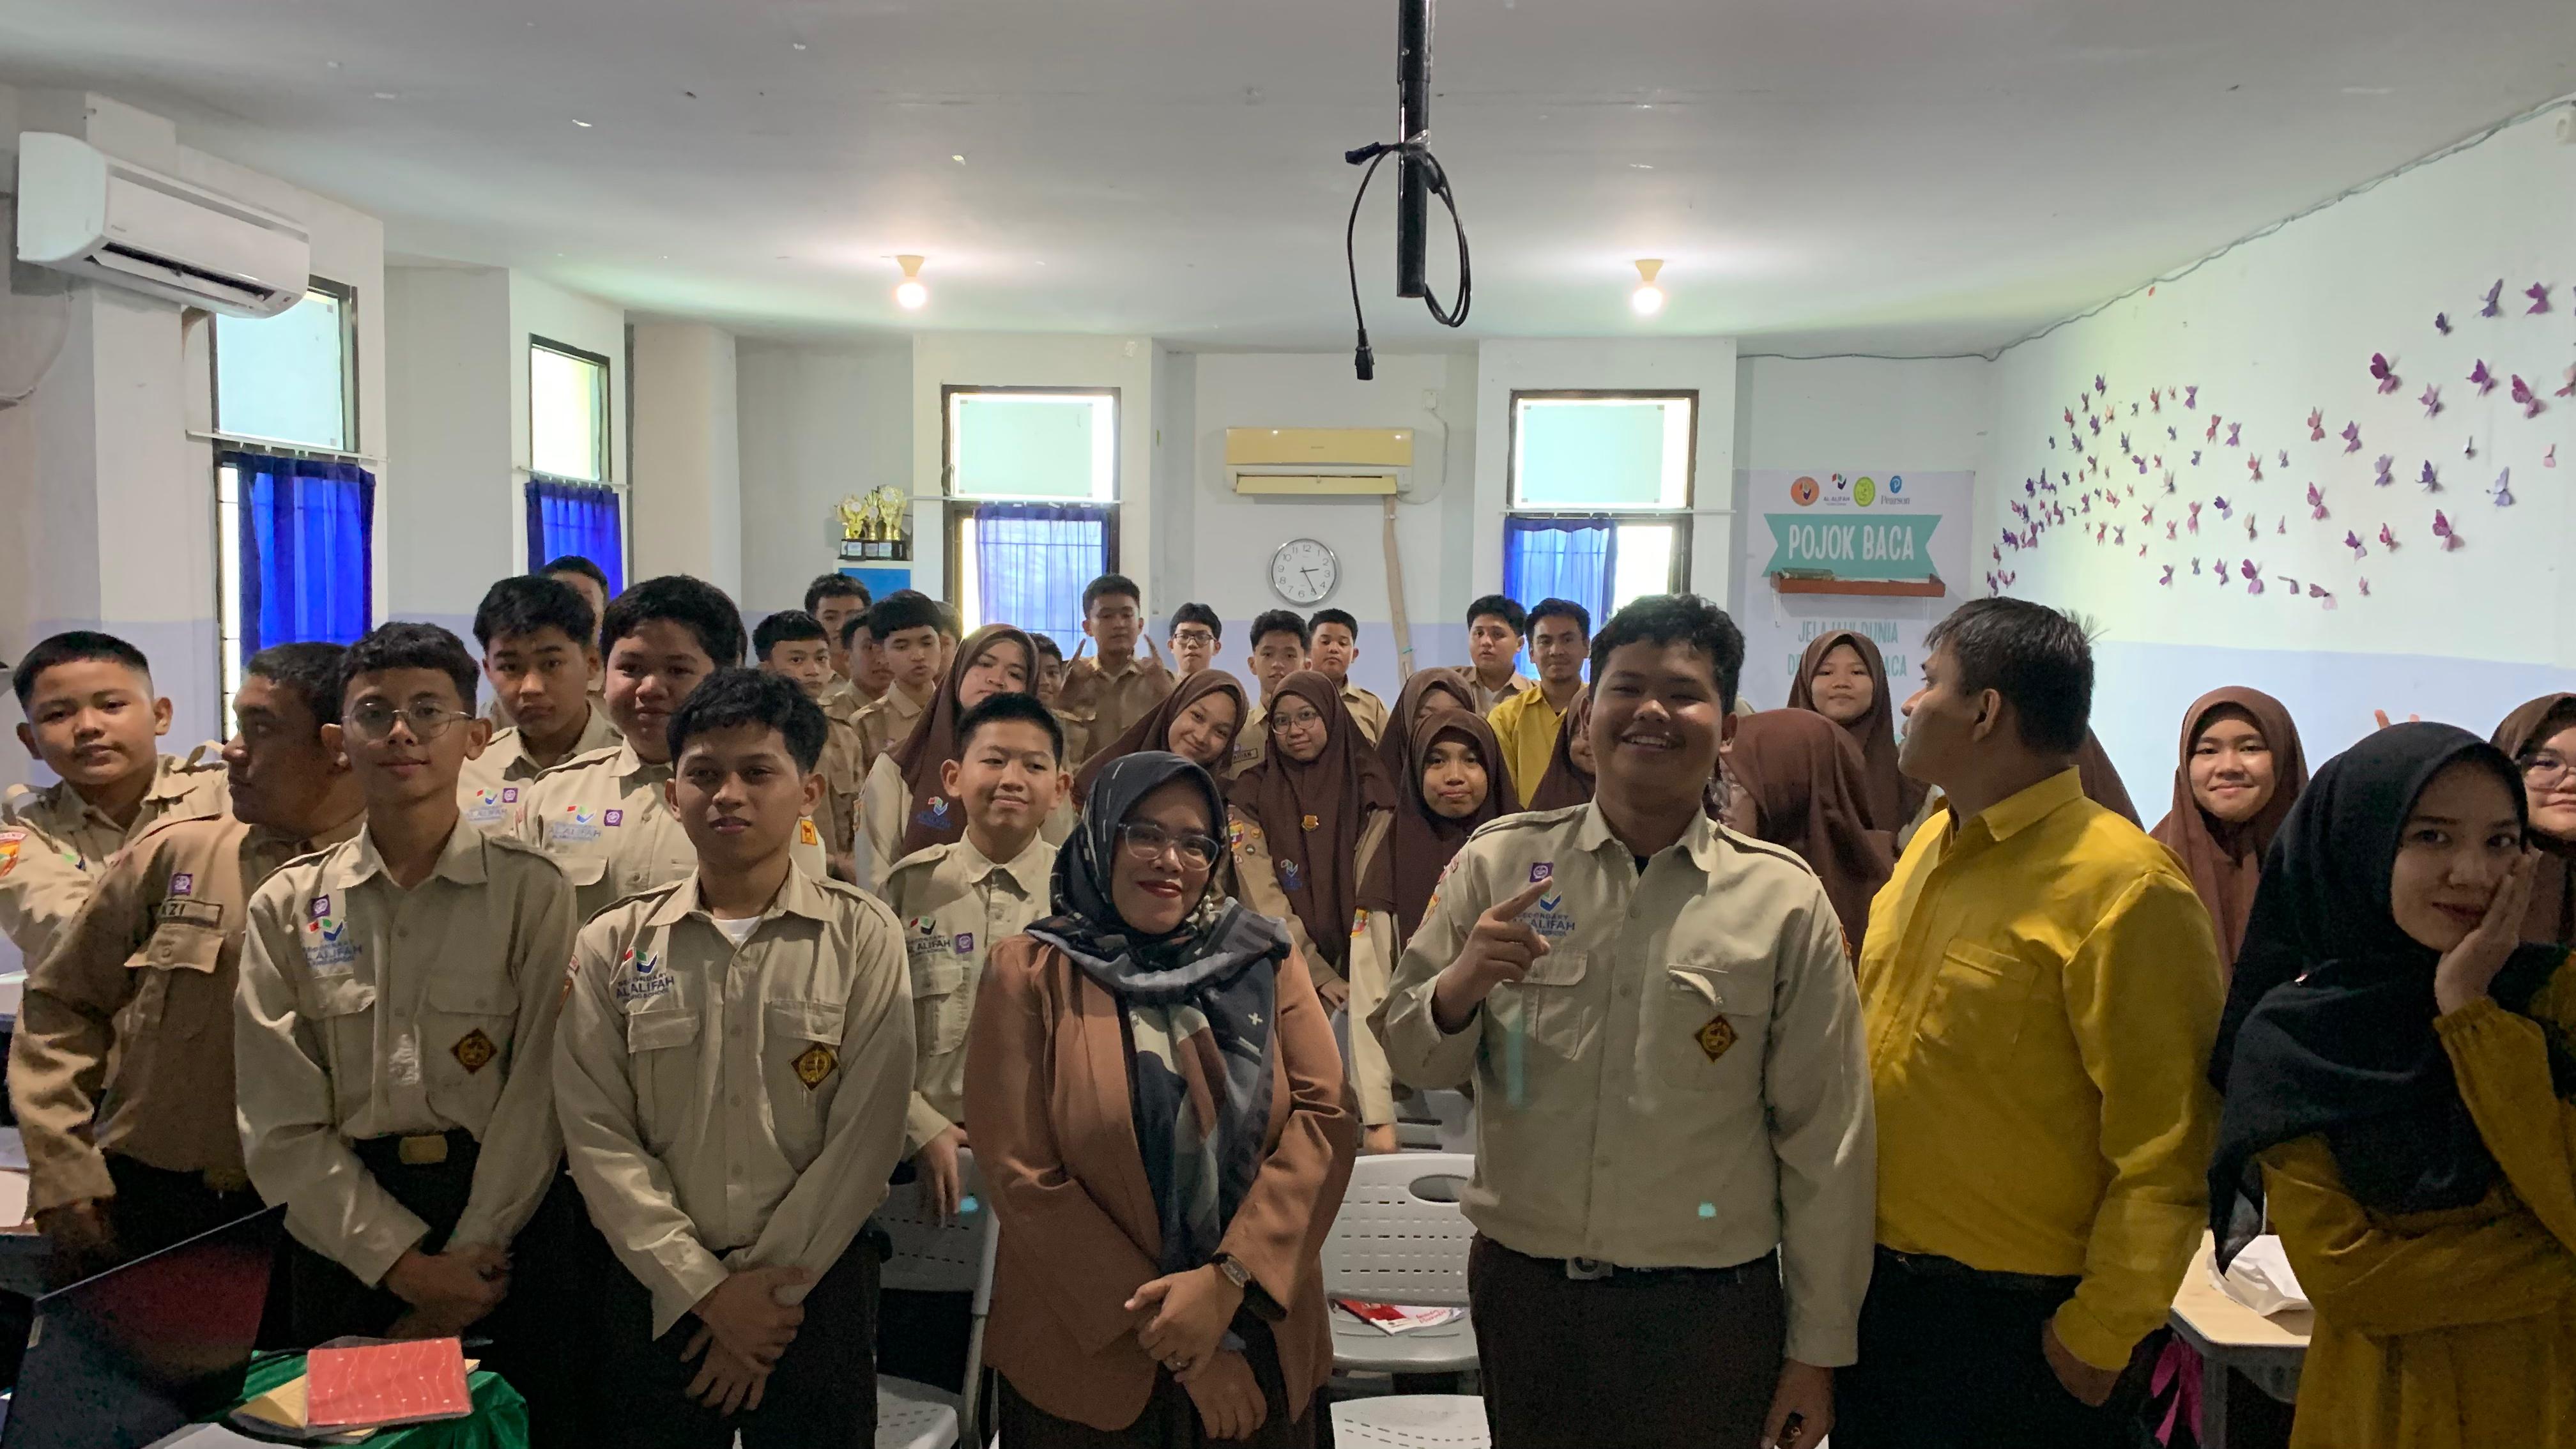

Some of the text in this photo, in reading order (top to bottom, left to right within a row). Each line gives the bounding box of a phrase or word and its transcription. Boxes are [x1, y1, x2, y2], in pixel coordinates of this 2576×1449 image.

[1881, 494, 1910, 505] Pearson
[1789, 524, 1914, 560] POJOK BACA
[1283, 553, 1292, 562] 10
[1322, 558, 1329, 566] 2
[1324, 569, 1331, 578] 3
[1280, 576, 1287, 585] 8
[1298, 590, 1305, 598] 6
[1531, 919, 1575, 931] ALIFAH
[917, 939, 951, 951] ALIFAH
[617, 987, 630, 999] AL
[631, 976, 675, 993] ALIFAH
